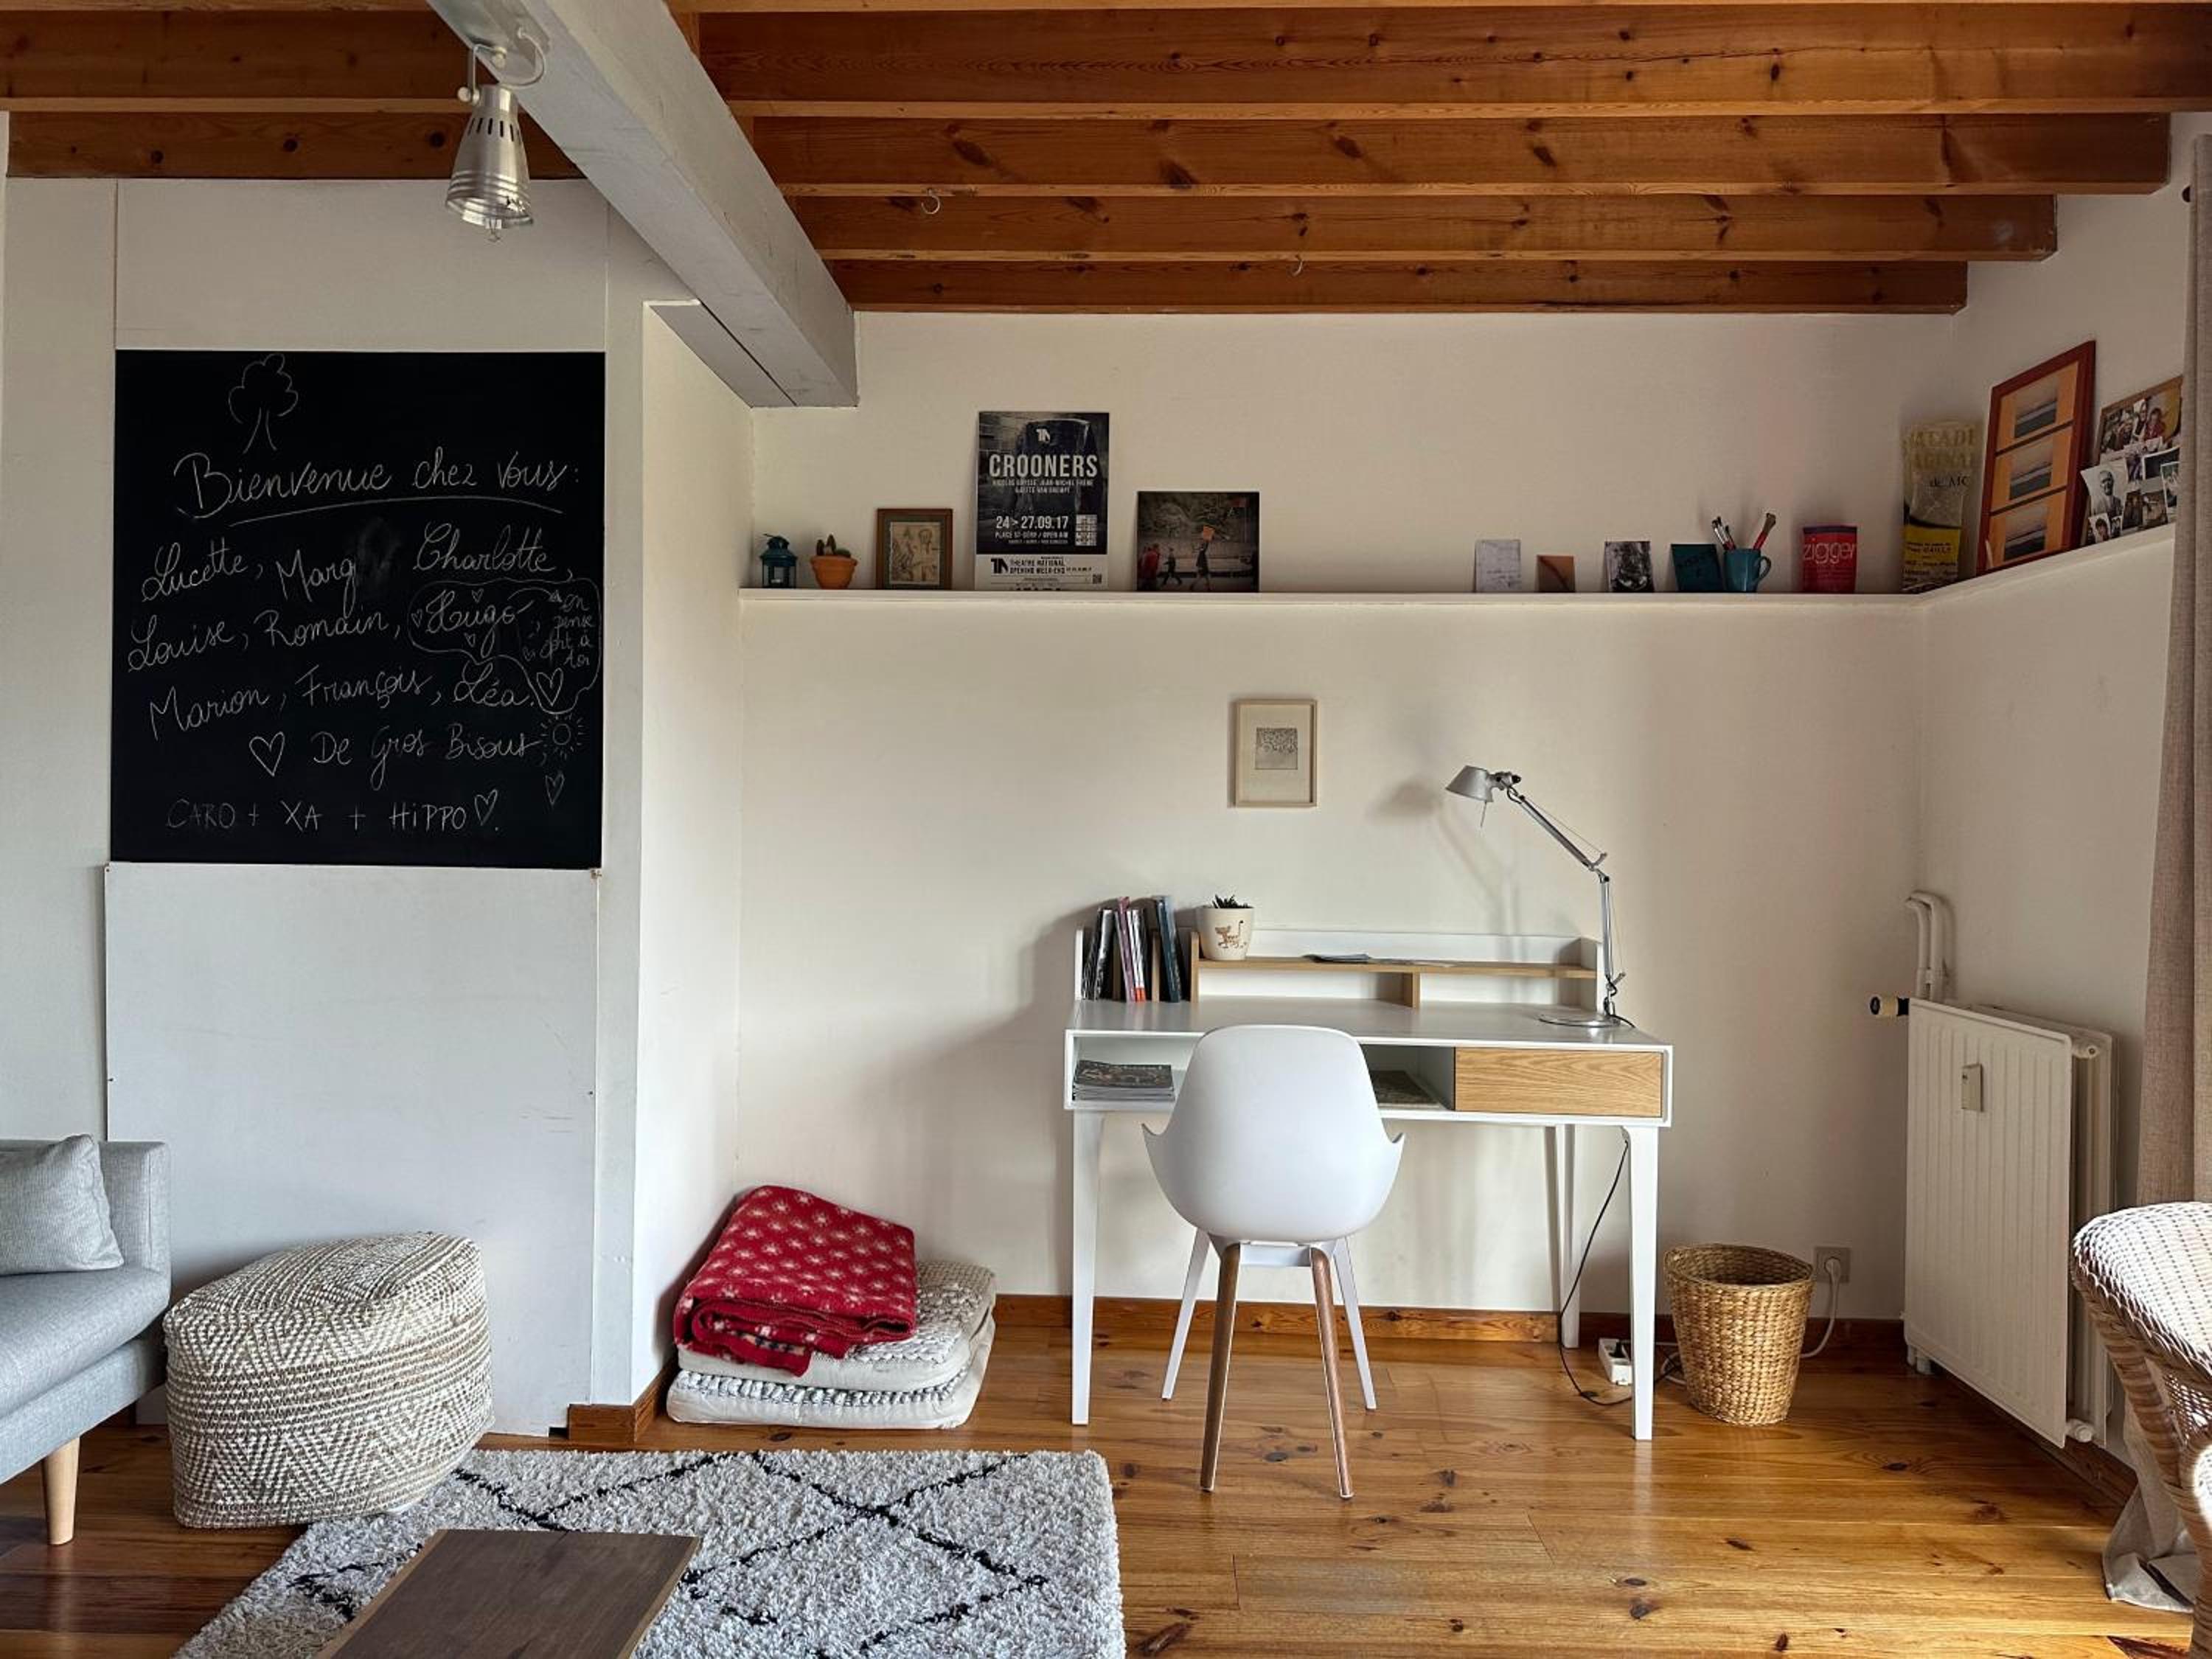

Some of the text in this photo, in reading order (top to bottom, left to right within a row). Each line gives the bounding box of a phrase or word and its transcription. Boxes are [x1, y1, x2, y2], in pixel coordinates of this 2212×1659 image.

[173, 452, 392, 519] Bienvenue
[411, 446, 478, 489] chez
[989, 454, 1098, 478] CROONERS
[425, 589, 535, 659] Hugo
[310, 731, 353, 765] De
[167, 798, 237, 830] CARO
